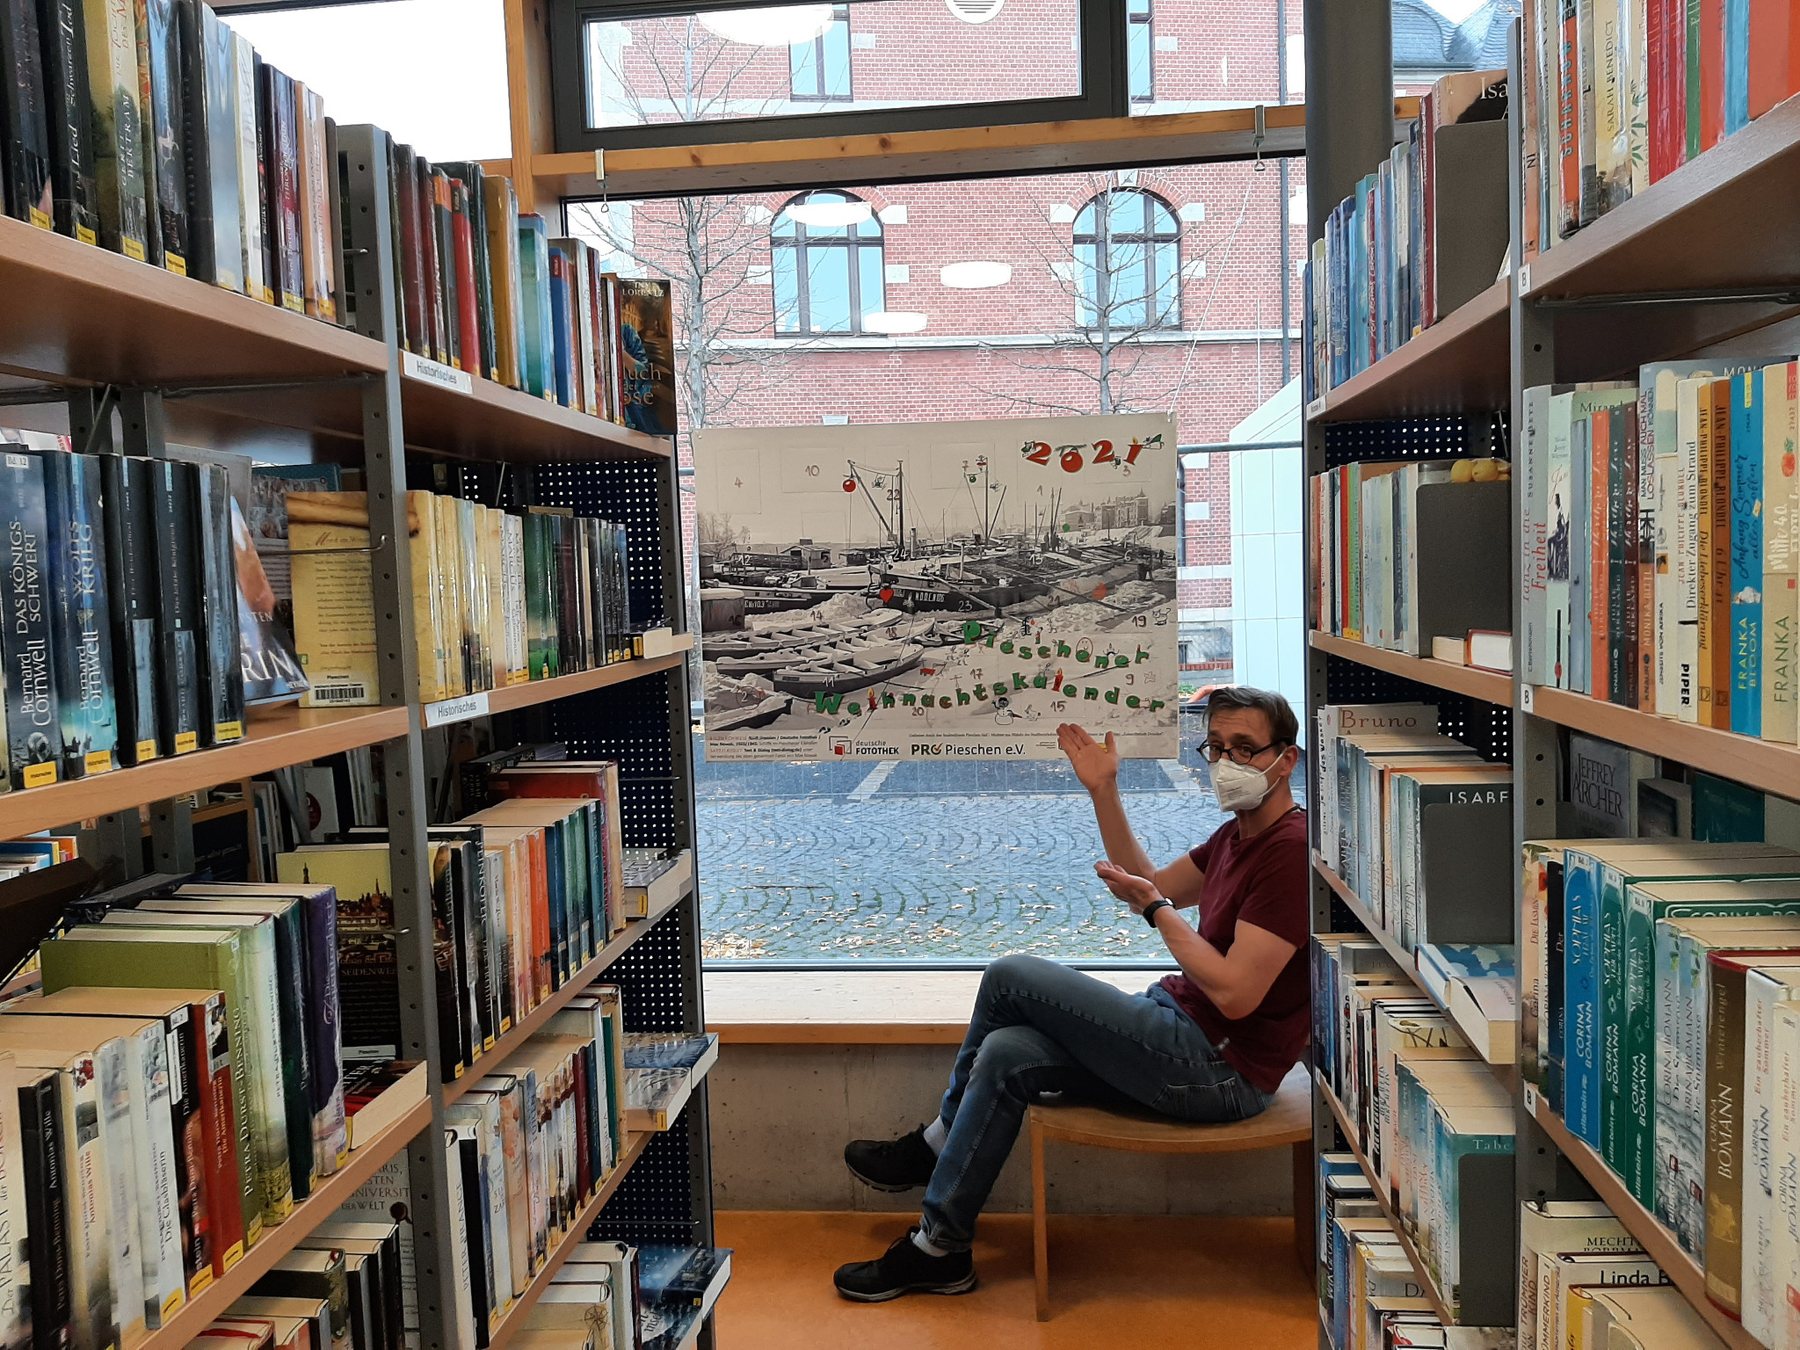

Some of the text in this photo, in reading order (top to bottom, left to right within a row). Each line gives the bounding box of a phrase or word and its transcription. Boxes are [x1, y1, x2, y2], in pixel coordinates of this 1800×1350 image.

[1480, 77, 1508, 100] Isa
[1604, 19, 1615, 132] SARAH BENEDICT
[122, 94, 135, 178] BERTRAM
[623, 362, 661, 380] luch
[623, 391, 654, 405] ose
[1640, 420, 1648, 446] AUCH
[804, 464, 820, 477] 10
[1025, 440, 1144, 473] 2021
[1526, 436, 1535, 499] SUSANNE
[1715, 405, 1726, 528] JEAN-PHILIPPE BLONDEL
[734, 476, 744, 488] 4
[886, 489, 900, 501] 22
[1685, 440, 1699, 609] Direkter Zugang zum Strand
[79, 523, 96, 594] KRIEG
[893, 549, 908, 561] 24
[1124, 550, 1132, 561] 6
[1531, 521, 1547, 592] Freiheit
[1735, 519, 1748, 579] Anfang
[1768, 531, 1788, 570] Mitte
[9, 515, 29, 634] DAS KÖNIGS-
[24, 530, 42, 622] SCHWERT
[809, 610, 823, 621] 14
[958, 601, 973, 611] 23
[1131, 616, 1147, 627] 19
[1642, 604, 1652, 647] MONIKA
[241, 649, 294, 682] RIN
[963, 620, 1150, 668] Pieschener
[1738, 617, 1748, 690] FRANKA
[1749, 621, 1757, 688] BLOOM
[1774, 616, 1789, 703] FRANKA
[16, 653, 35, 713] Bernard
[25, 638, 53, 726] Cornwell
[76, 645, 89, 710] Bernard
[81, 629, 105, 724] Cornwell
[814, 668, 1165, 715] Weihnachtskalender
[822, 676, 836, 688] 11
[969, 668, 984, 679] 17
[1125, 673, 1134, 685] 9
[1643, 664, 1651, 701] KNAUR
[1680, 663, 1690, 706] PIPER
[437, 700, 477, 718] Historisches
[911, 707, 925, 717] 20
[1050, 700, 1066, 712] 15
[1340, 709, 1418, 730] Bruno
[856, 746, 899, 755] FOTOTHEK
[946, 745, 1005, 755] Pieschen
[1007, 745, 1026, 755] e.V.
[1577, 752, 1617, 788] JEFFREY
[1572, 777, 1625, 819] ARCHER
[1529, 978, 1539, 1018] Corina
[1576, 1003, 1586, 1058] CORINA
[1583, 1000, 1593, 1070] BOMANN
[1761, 1027, 1770, 1074] Sommer
[177, 1032, 190, 1097] Amerikanerin
[1605, 1024, 1614, 1082] CORINA
[1610, 1022, 1619, 1094] BOMANN
[1631, 1054, 1641, 1114] CORINA
[1637, 1052, 1648, 1127] BOMANN
[1664, 1051, 1673, 1106] CORINA
[1753, 1076, 1763, 1095] Ein
[182, 1099, 191, 1116] Die
[232, 1007, 254, 1196] PETRA DURST-BENNING
[1693, 1099, 1703, 1125] Die
[1709, 1097, 1718, 1154] CORINA
[1717, 1082, 1734, 1180] BOMANN
[1751, 1118, 1760, 1166] CORINA
[1781, 1124, 1791, 1143] Ein
[42, 1110, 58, 1189] Antonias Wille
[84, 1150, 96, 1224] Antonias Wille
[158, 1150, 173, 1242] Die Glasbläserin
[356, 1201, 386, 1211] WELT
[1778, 1165, 1789, 1214] CORINA
[193, 1237, 204, 1270] stein
[1520, 1256, 1528, 1328] TRÜMMER
[1528, 1280, 1536, 1316] KIND
[1600, 1270, 1650, 1284] Linda
